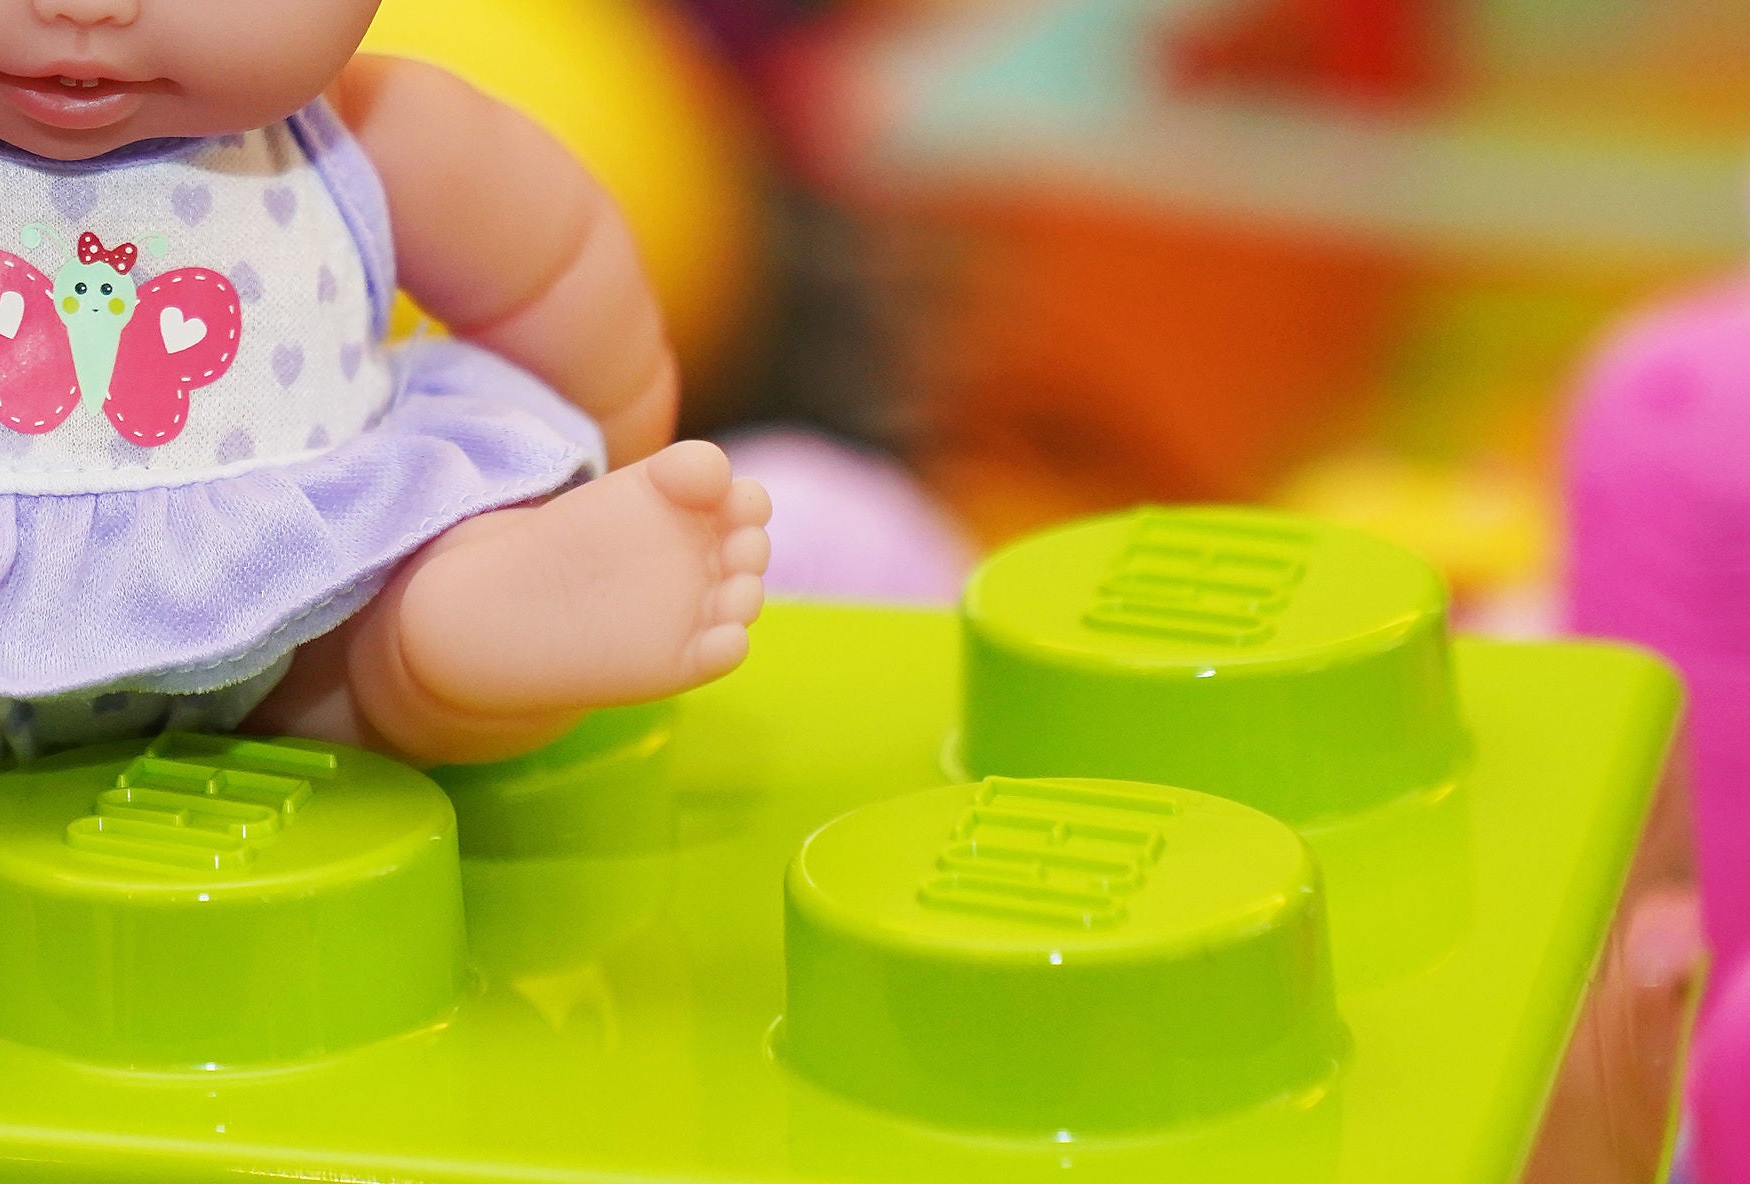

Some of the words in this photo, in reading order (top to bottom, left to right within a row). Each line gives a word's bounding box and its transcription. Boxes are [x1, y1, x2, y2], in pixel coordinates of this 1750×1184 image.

[1076, 504, 1316, 648] LEGO
[65, 731, 338, 874] LEGO
[914, 775, 1181, 934] LEGO
